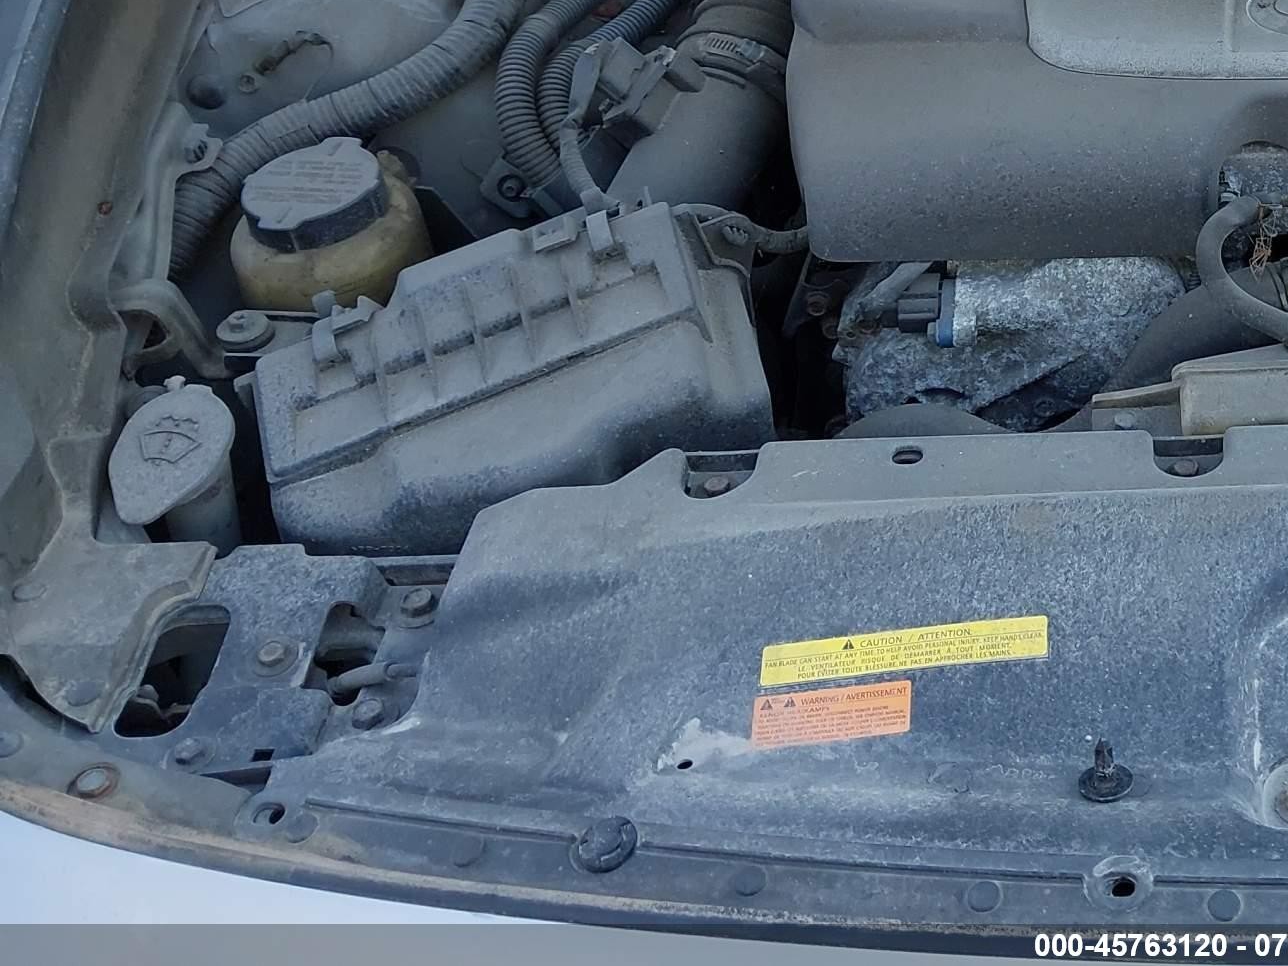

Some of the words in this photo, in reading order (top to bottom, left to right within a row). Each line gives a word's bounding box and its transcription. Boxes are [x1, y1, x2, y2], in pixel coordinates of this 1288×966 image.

[860, 636, 903, 648] CAUTION
[908, 633, 914, 642] /
[778, 659, 797, 668] BLADE
[799, 657, 813, 665] CAN
[815, 655, 833, 663] START
[845, 652, 858, 660] ANY
[860, 650, 873, 658] TIME
[876, 648, 885, 656] TO
[886, 646, 902, 655] HELP
[903, 644, 923, 653] AVOID
[924, 640, 957, 650] PERSONAL
[797, 671, 815, 680] POUR
[842, 666, 862, 675] TOUTE
[910, 658, 922, 666] PAS
[935, 653, 973, 664] APPROCHER
[976, 651, 987, 659] LES
[811, 659, 855, 671] VENTILATEUR
[890, 653, 899, 661] DE
[956, 646, 973, 654] TOUT
[801, 695, 839, 706] WARNING
[845, 686, 907, 701] AVERTISSEMENT
